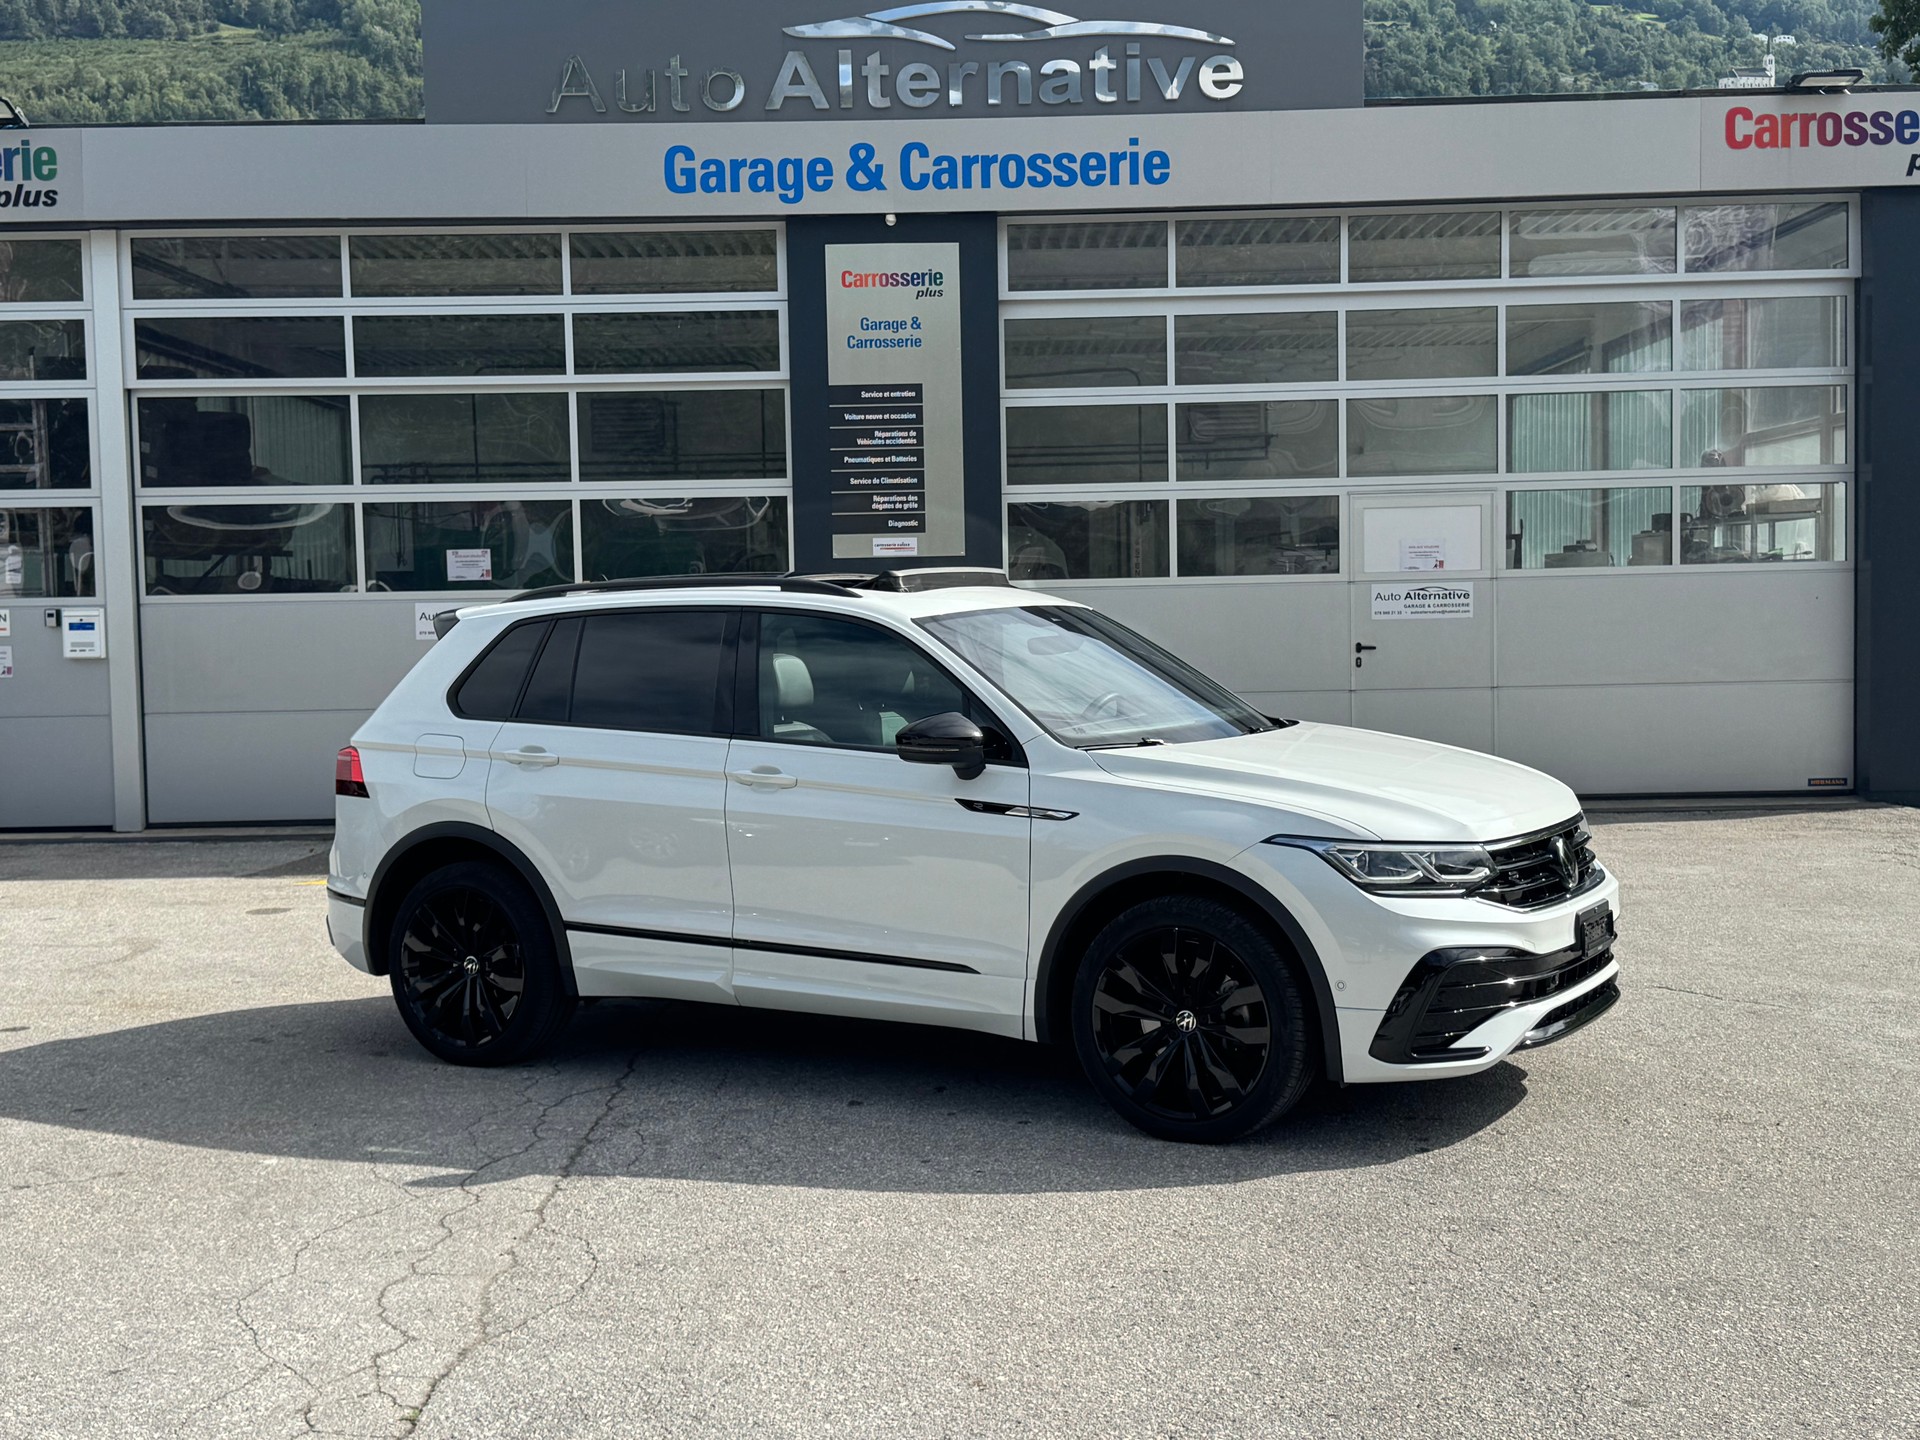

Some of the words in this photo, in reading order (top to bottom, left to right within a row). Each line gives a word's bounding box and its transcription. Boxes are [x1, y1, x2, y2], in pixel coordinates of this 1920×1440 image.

[545, 54, 745, 113] Auto
[765, 42, 1244, 110] Alternative
[0, 139, 57, 181] rie
[664, 145, 834, 204] Garage
[846, 142, 887, 191] &
[900, 137, 1170, 190] Carrosserie
[841, 269, 944, 288] Carrosserie
[915, 287, 944, 300] plus
[860, 317, 907, 333] Garage
[910, 316, 922, 330] &
[847, 334, 922, 349] Carrosserie
[861, 390, 883, 398] Service
[844, 456, 884, 464] Pneumatiques
[850, 477, 872, 485] Service
[880, 476, 918, 484] Climatisation
[888, 519, 919, 528] Diagnostic
[1374, 592, 1402, 602] Auto
[1404, 591, 1470, 601] Alternative
[419, 611, 438, 622] Au
